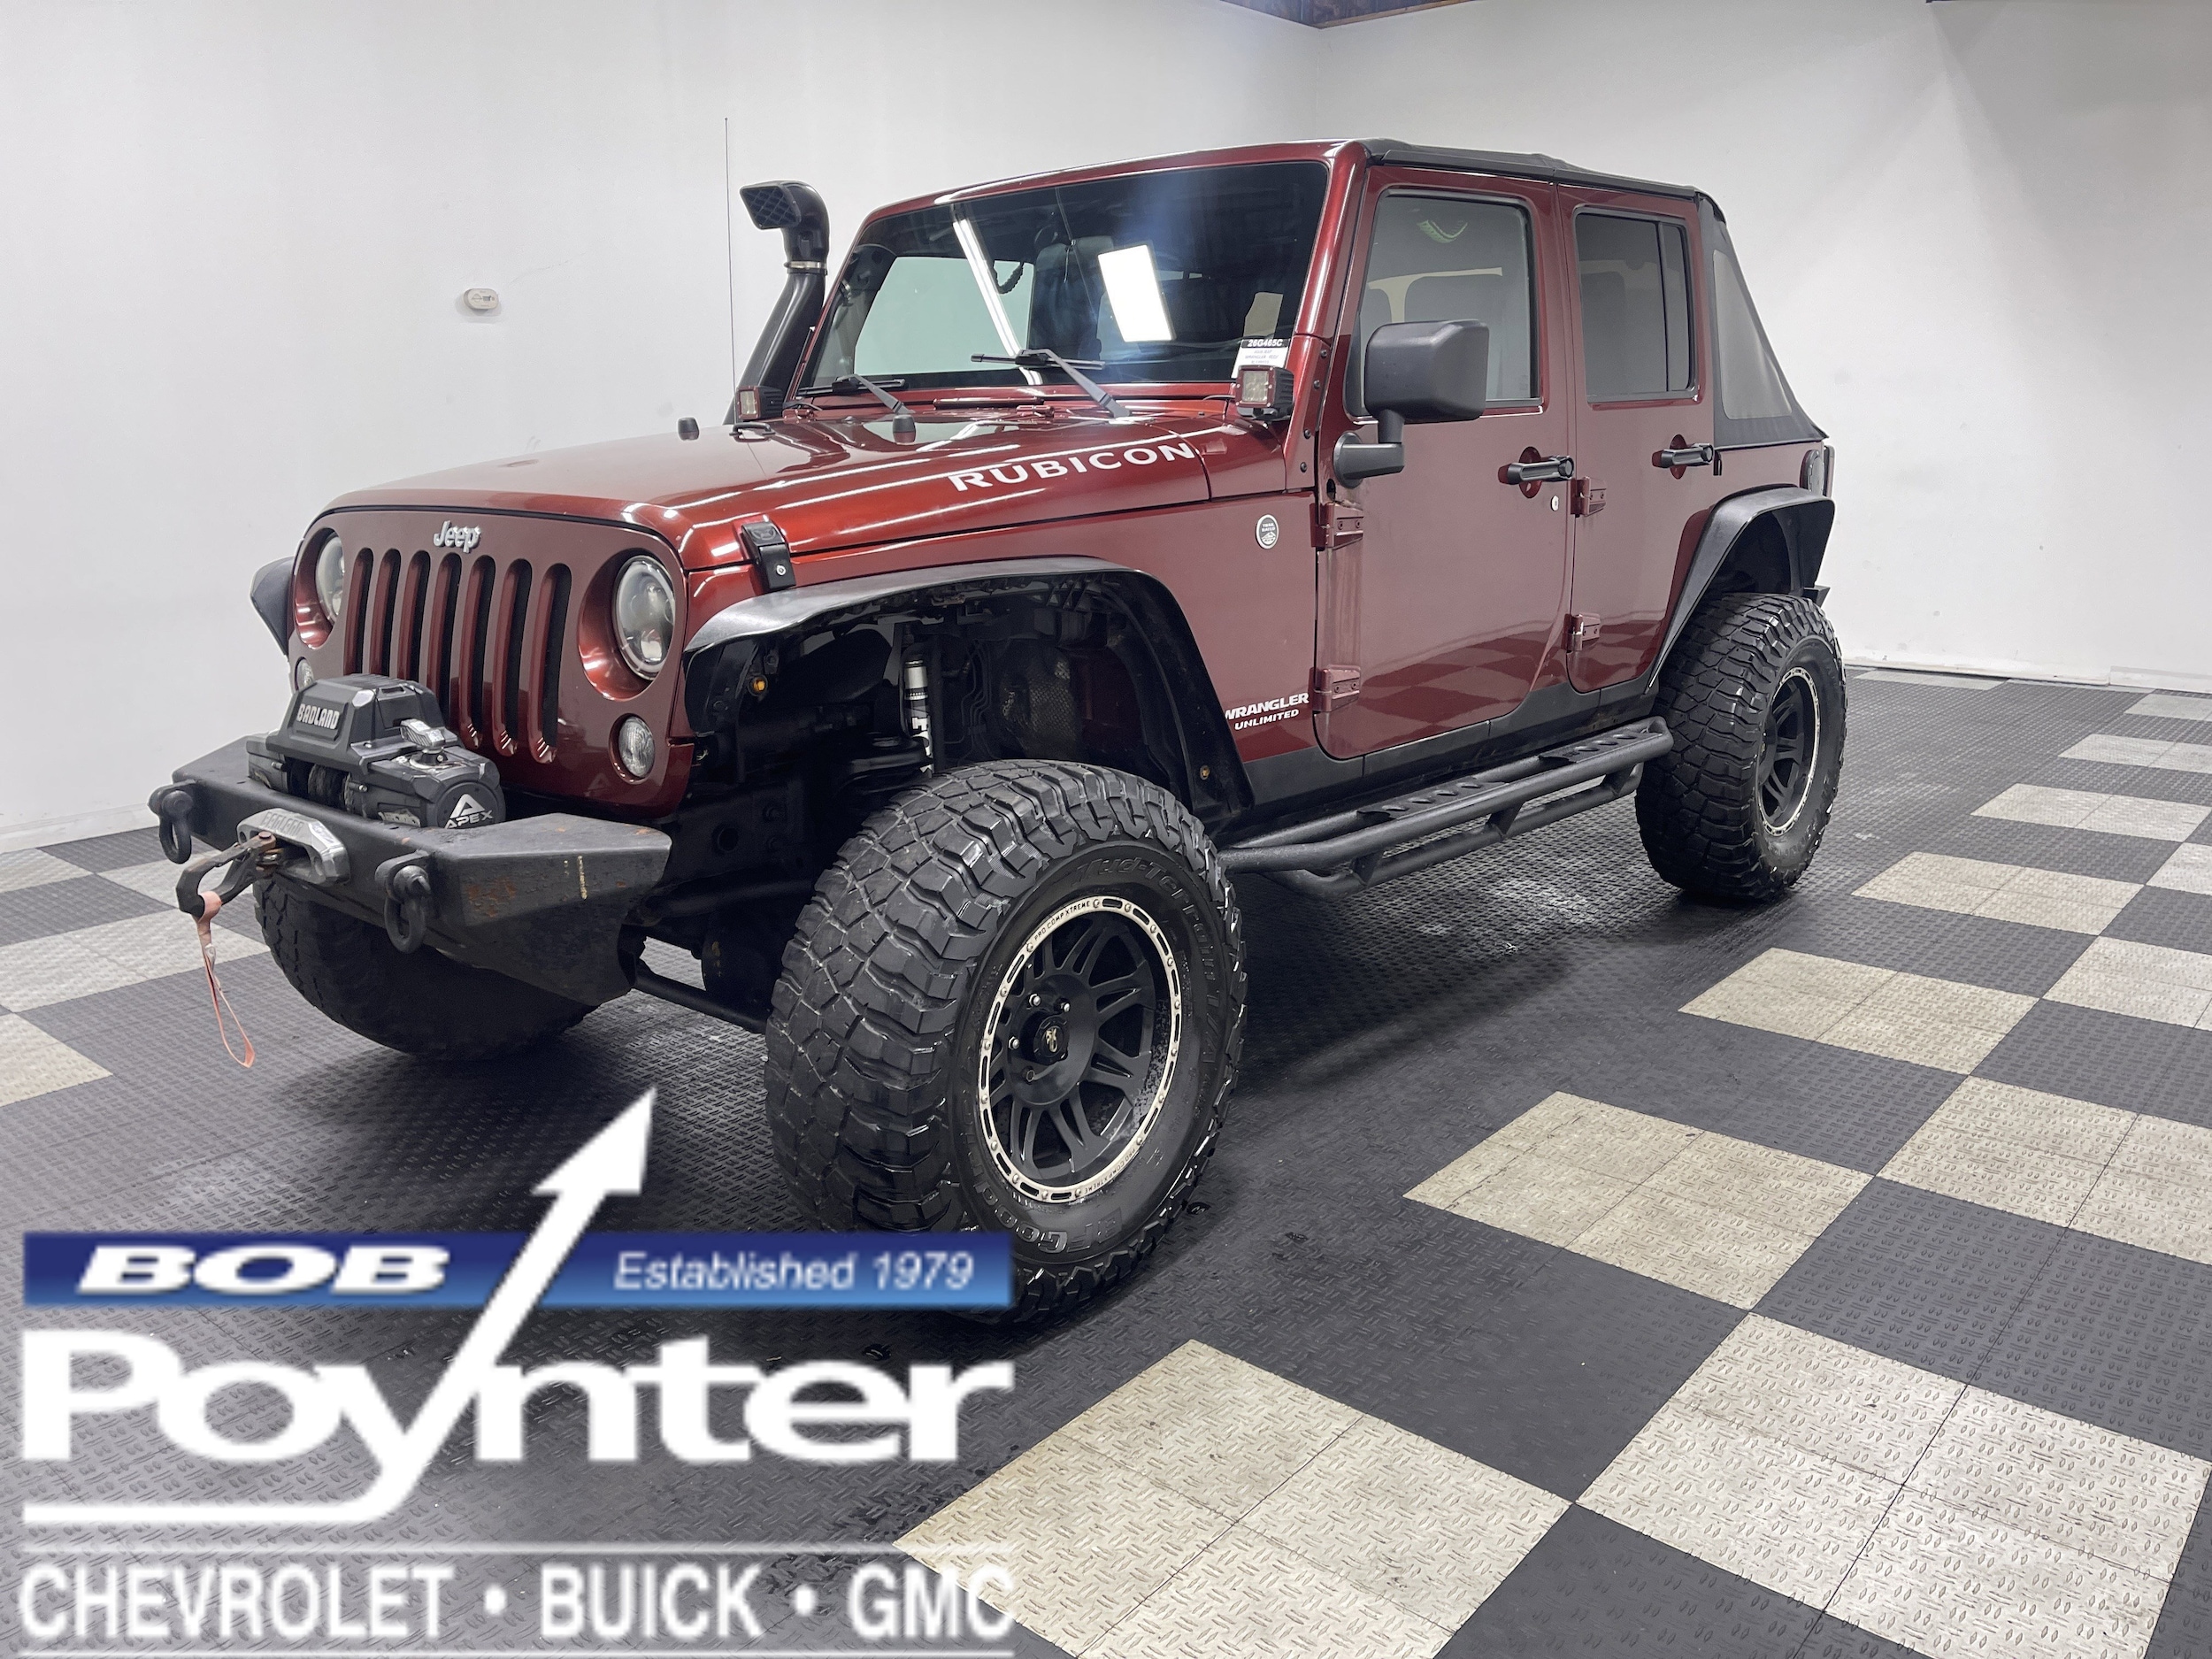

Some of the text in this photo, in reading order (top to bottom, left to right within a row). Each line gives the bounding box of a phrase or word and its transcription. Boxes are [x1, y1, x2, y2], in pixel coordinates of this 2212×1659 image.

[949, 442, 1195, 491] RUBICON
[434, 520, 481, 553] Jeep
[296, 703, 340, 730] BADLAND
[1225, 692, 1310, 720] WRANGLER
[1234, 709, 1299, 730] UNLIMITED
[444, 810, 494, 829] APEX
[1034, 901, 1090, 941] PRO COMP XTREME
